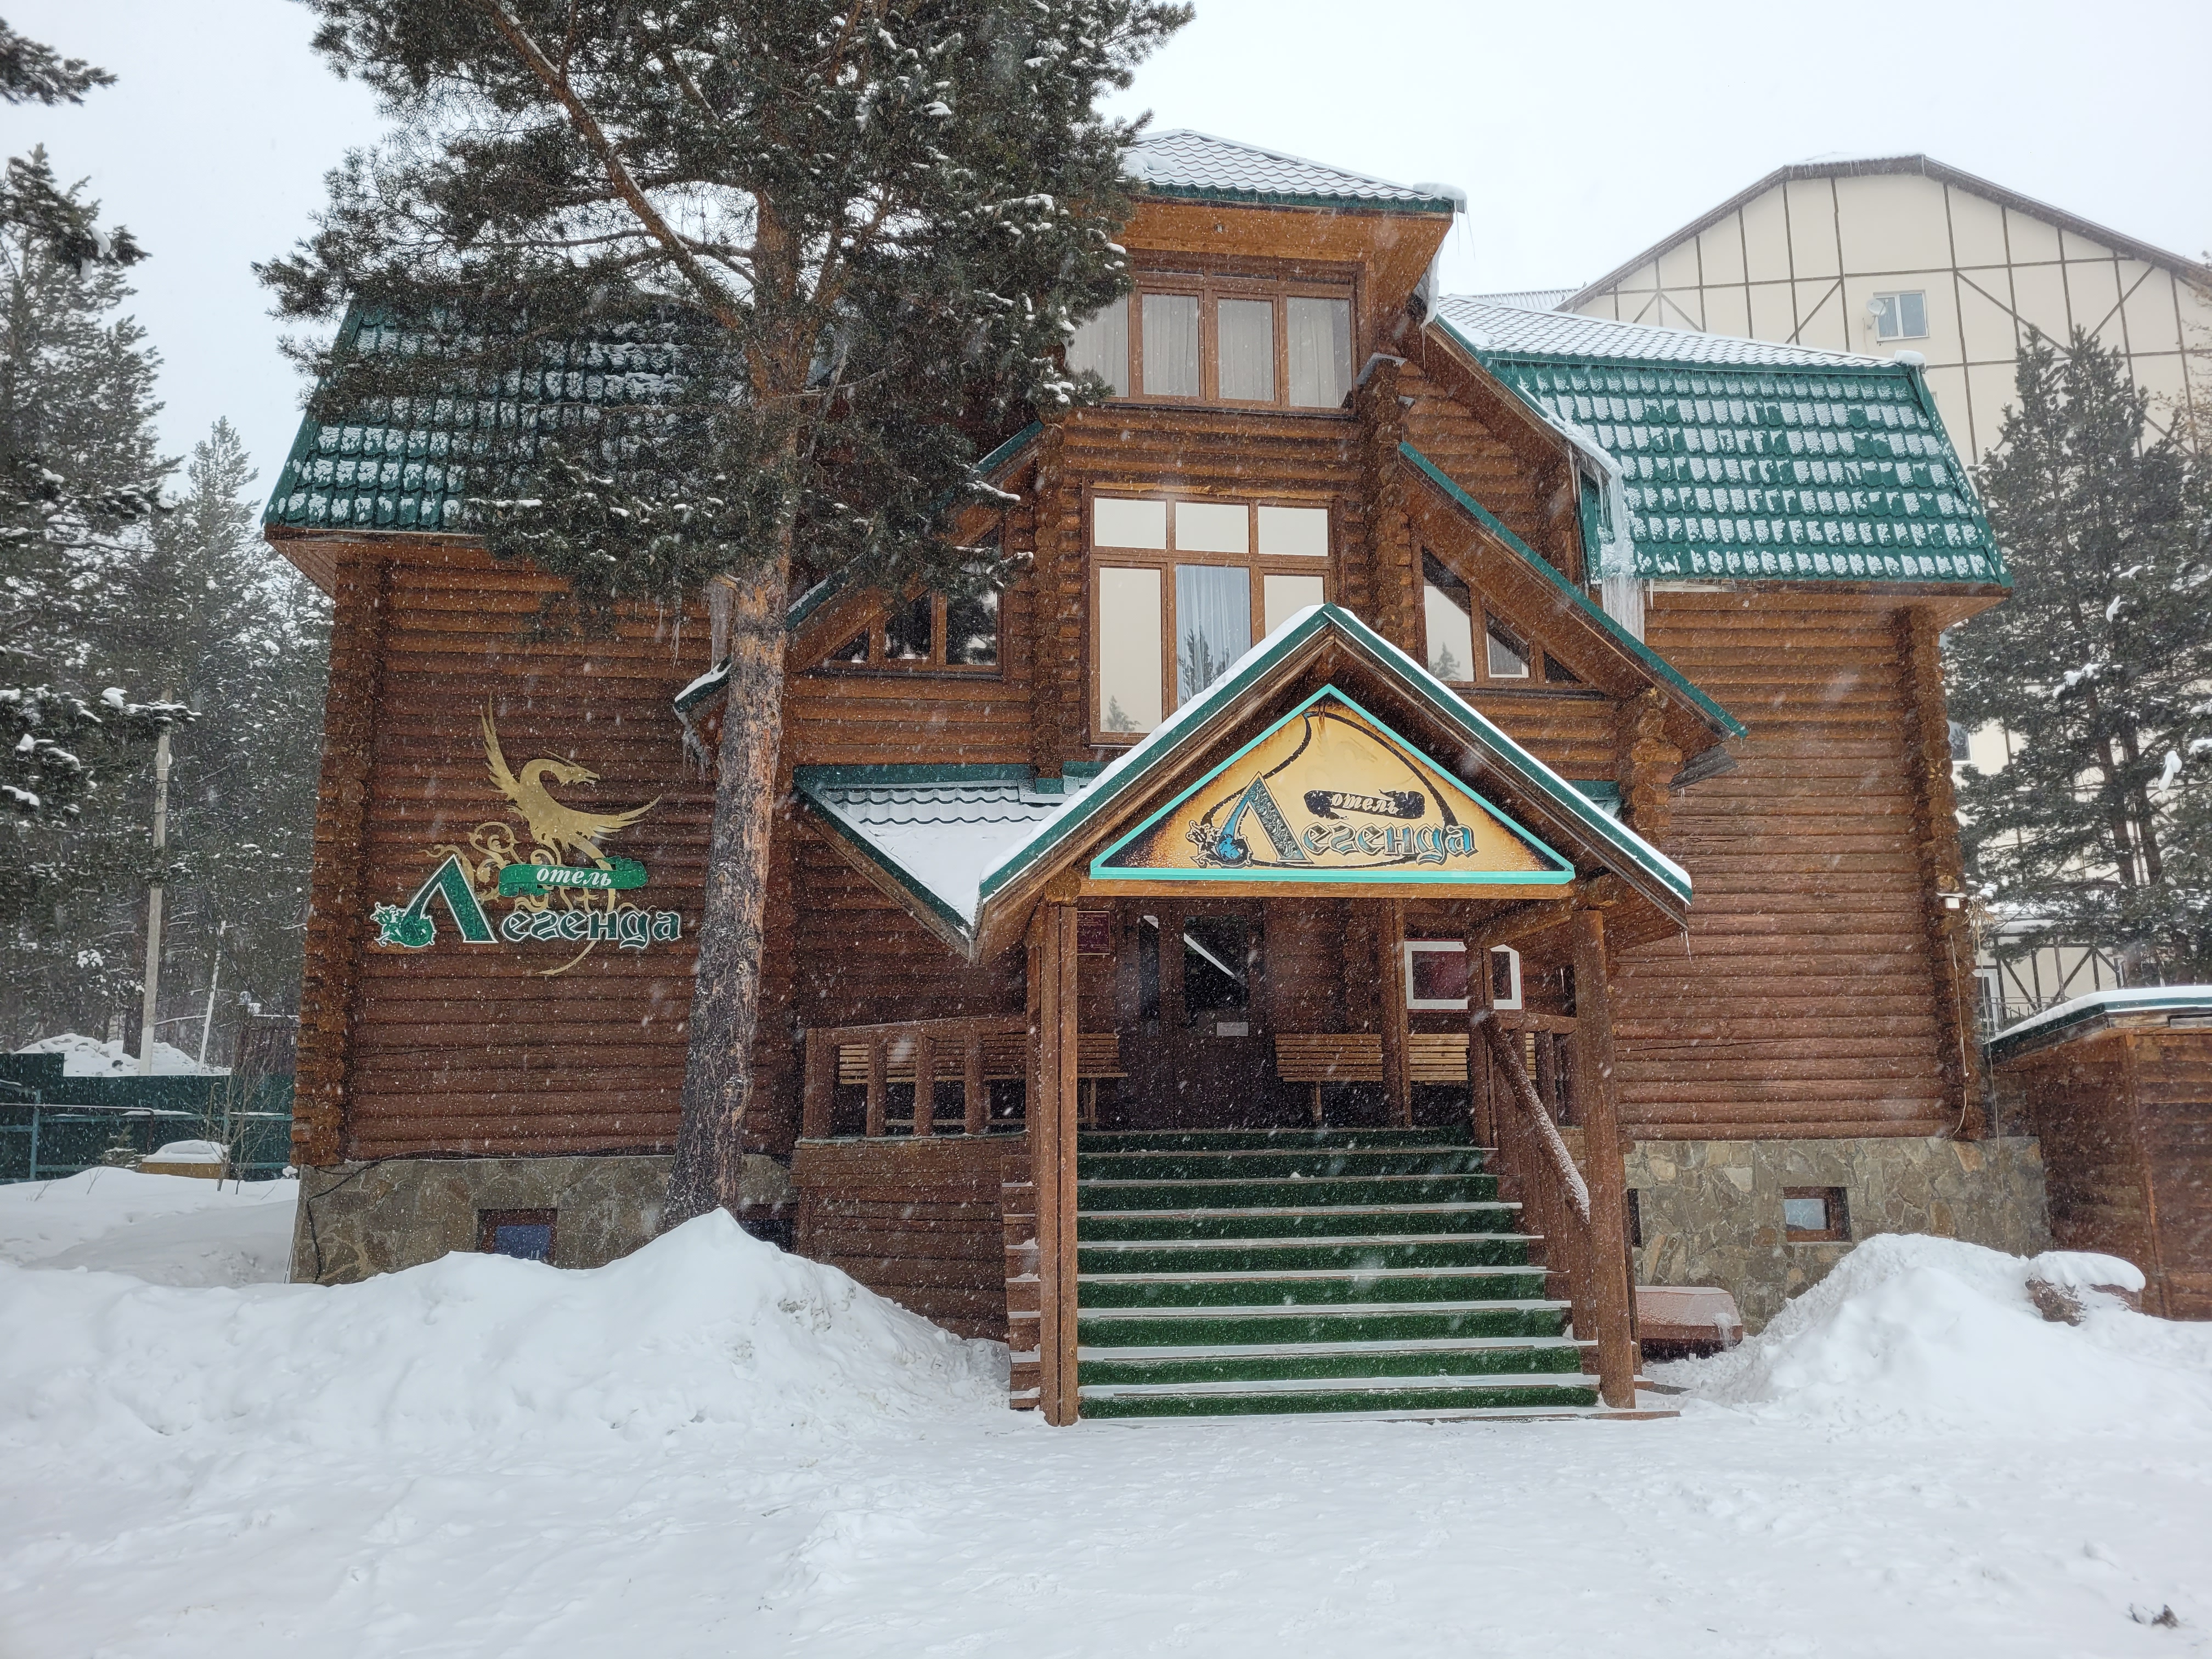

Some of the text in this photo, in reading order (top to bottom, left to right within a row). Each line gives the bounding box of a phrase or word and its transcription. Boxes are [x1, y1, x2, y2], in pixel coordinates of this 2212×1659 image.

[1185, 771, 1478, 868] Легенда
[1331, 793, 1400, 814] отель
[370, 854, 681, 949] Легенда
[536, 868, 612, 886] отель
